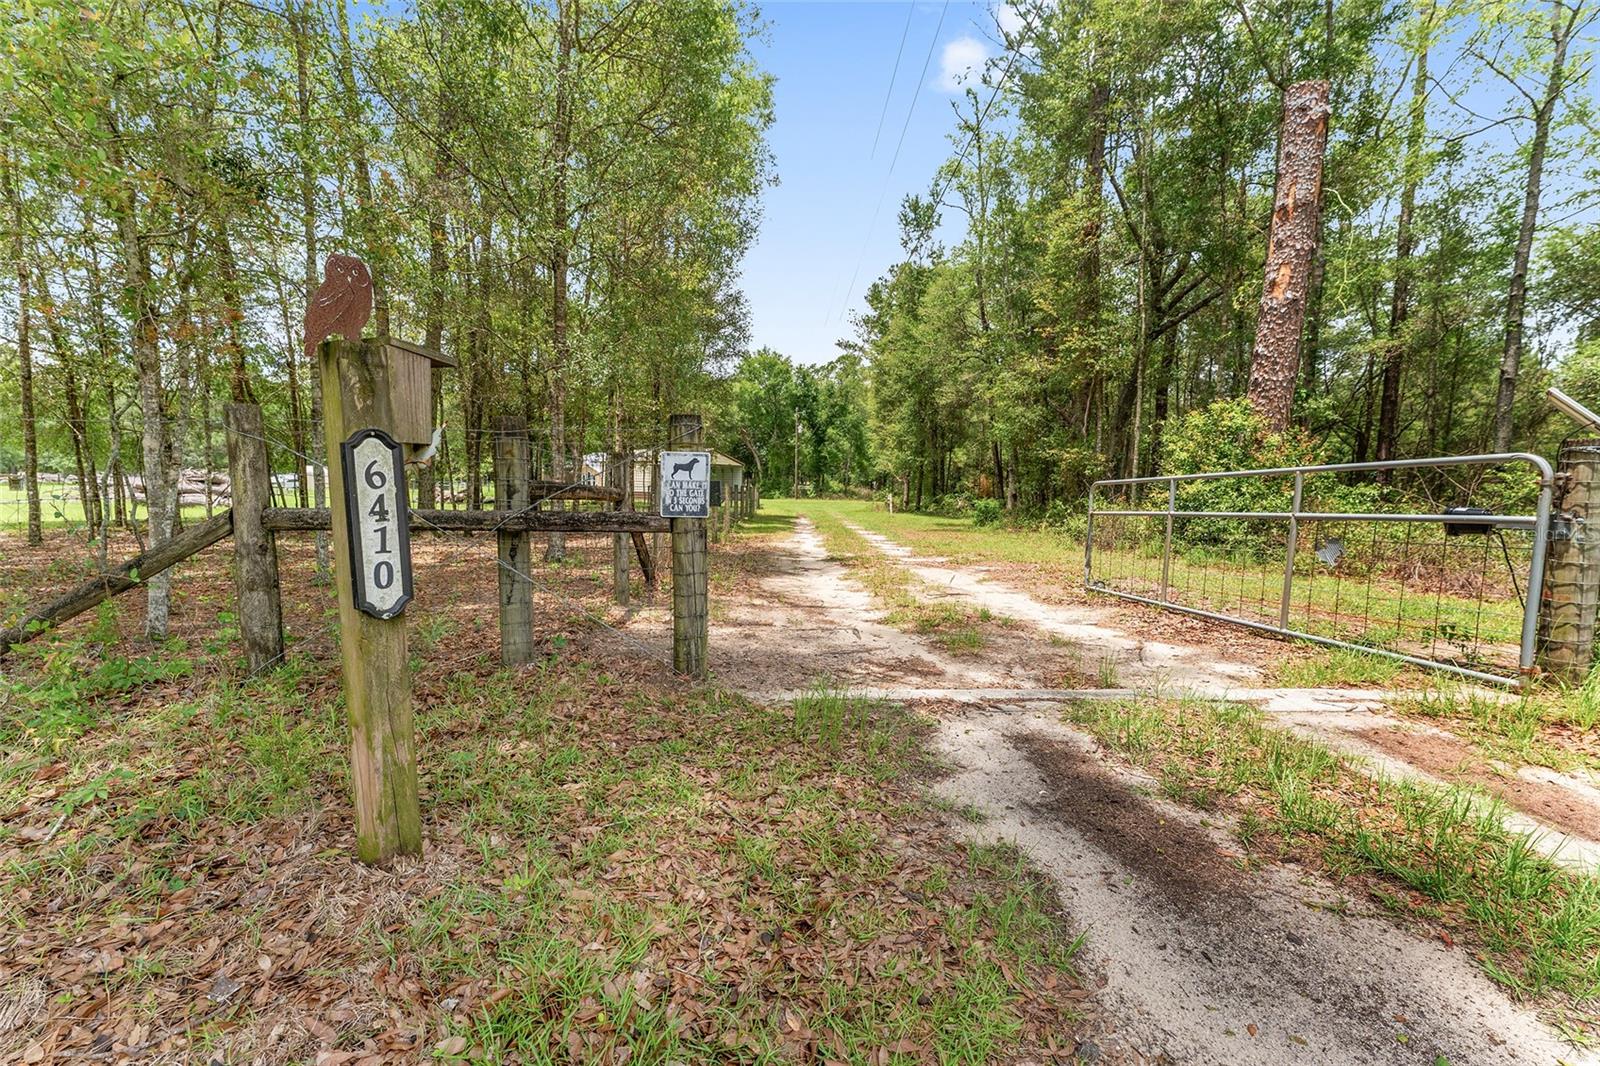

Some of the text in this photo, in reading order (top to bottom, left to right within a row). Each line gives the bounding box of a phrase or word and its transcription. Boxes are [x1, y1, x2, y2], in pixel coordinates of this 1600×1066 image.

[667, 481, 681, 489] AN
[682, 481, 701, 489] MAKE
[364, 459, 394, 590] 6410
